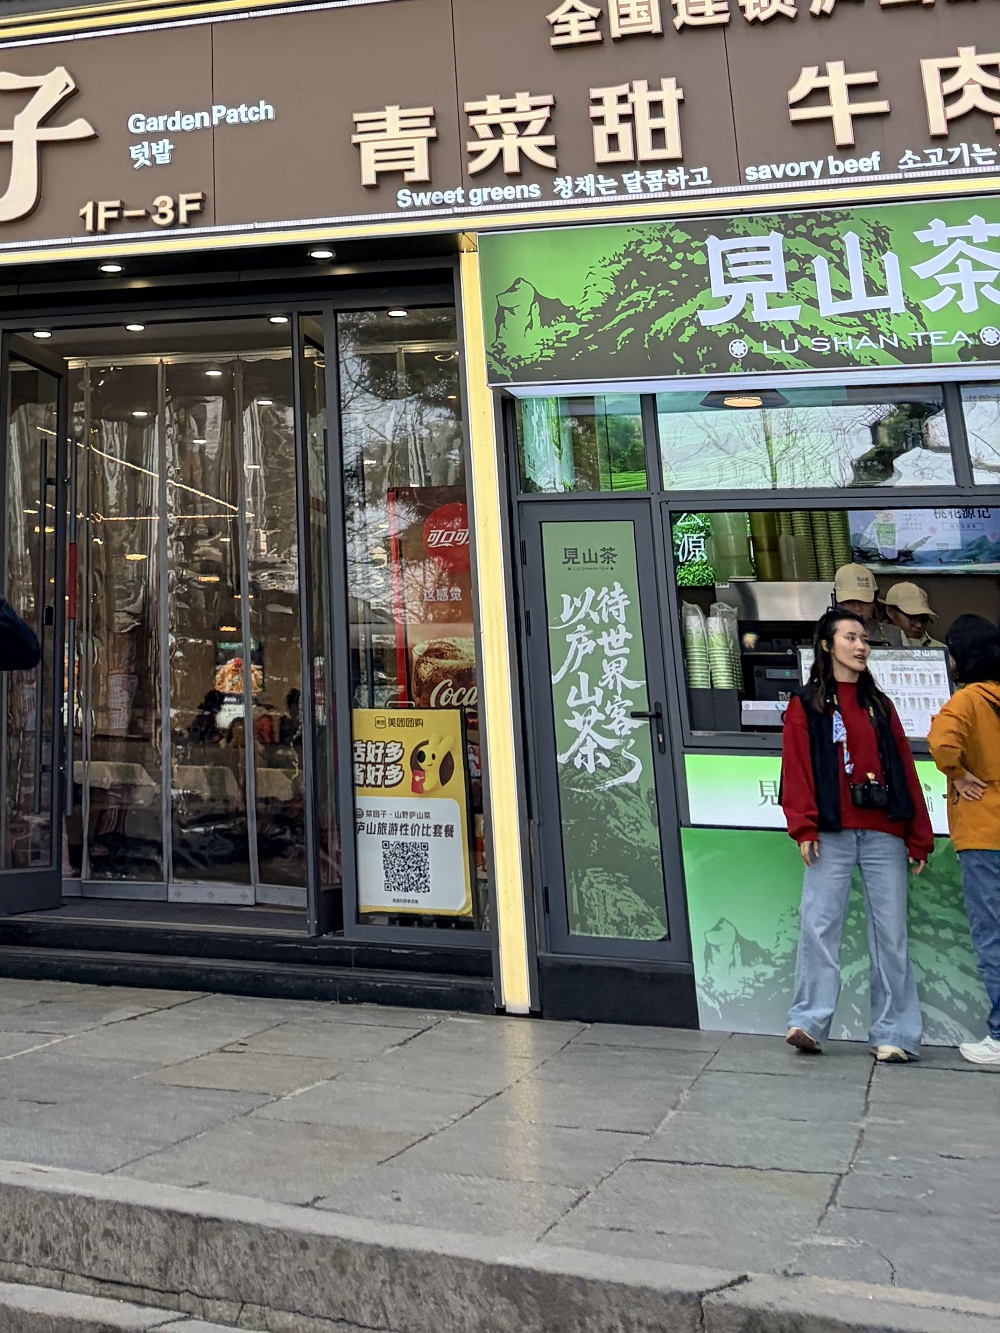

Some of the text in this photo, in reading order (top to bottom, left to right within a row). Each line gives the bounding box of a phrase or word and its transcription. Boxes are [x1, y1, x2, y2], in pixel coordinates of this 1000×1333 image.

[128, 100, 276, 135] Garden Patch
[351, 46, 1000, 187] 青菜甜 牛肉
[745, 151, 882, 183] savory beef
[898, 143, 997, 170] 소고기는
[396, 181, 542, 209] Sweet greens
[553, 166, 713, 199] 청채는 달콤하고
[697, 214, 1000, 327] 見山茶
[762, 329, 974, 355] LU SHAN TEA
[427, 528, 470, 548] 可口可
[562, 547, 618, 565] 見山茶
[387, 717, 424, 728] 美团团购
[758, 779, 779, 806] 見
